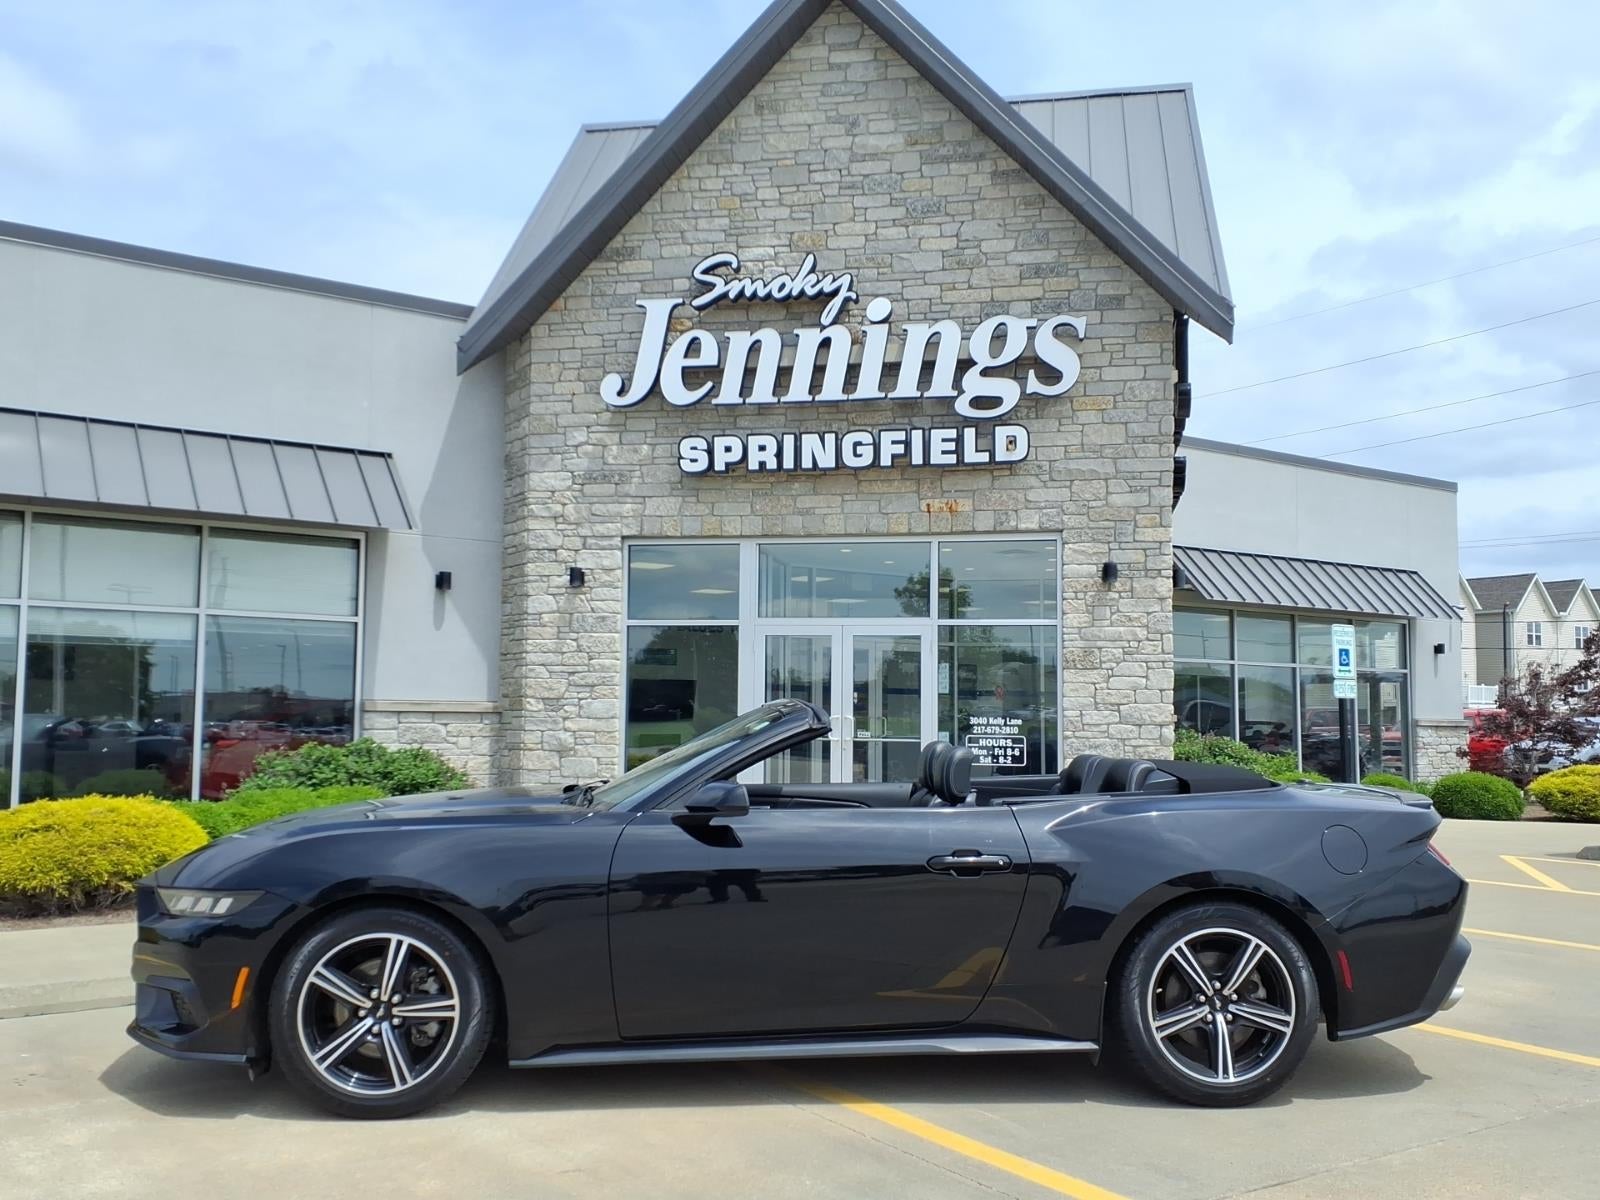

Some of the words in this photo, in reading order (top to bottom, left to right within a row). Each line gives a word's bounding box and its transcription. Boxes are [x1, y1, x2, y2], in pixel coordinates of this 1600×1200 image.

[691, 252, 857, 326] Smoky
[600, 297, 1087, 420] Jennings
[678, 424, 1030, 475] SPRINGFIELD
[969, 717, 987, 725] 3040
[989, 717, 1005, 726] Kelly
[1006, 717, 1023, 725] Lane
[972, 726, 1019, 734] 217-679-2810
[979, 738, 1013, 747] HOURS
[971, 747, 988, 755] Mon
[994, 748, 1005, 756] Fri
[1006, 748, 1020, 756] 8-6
[979, 756, 992, 764] Sat
[998, 756, 1012, 764] 8-2
